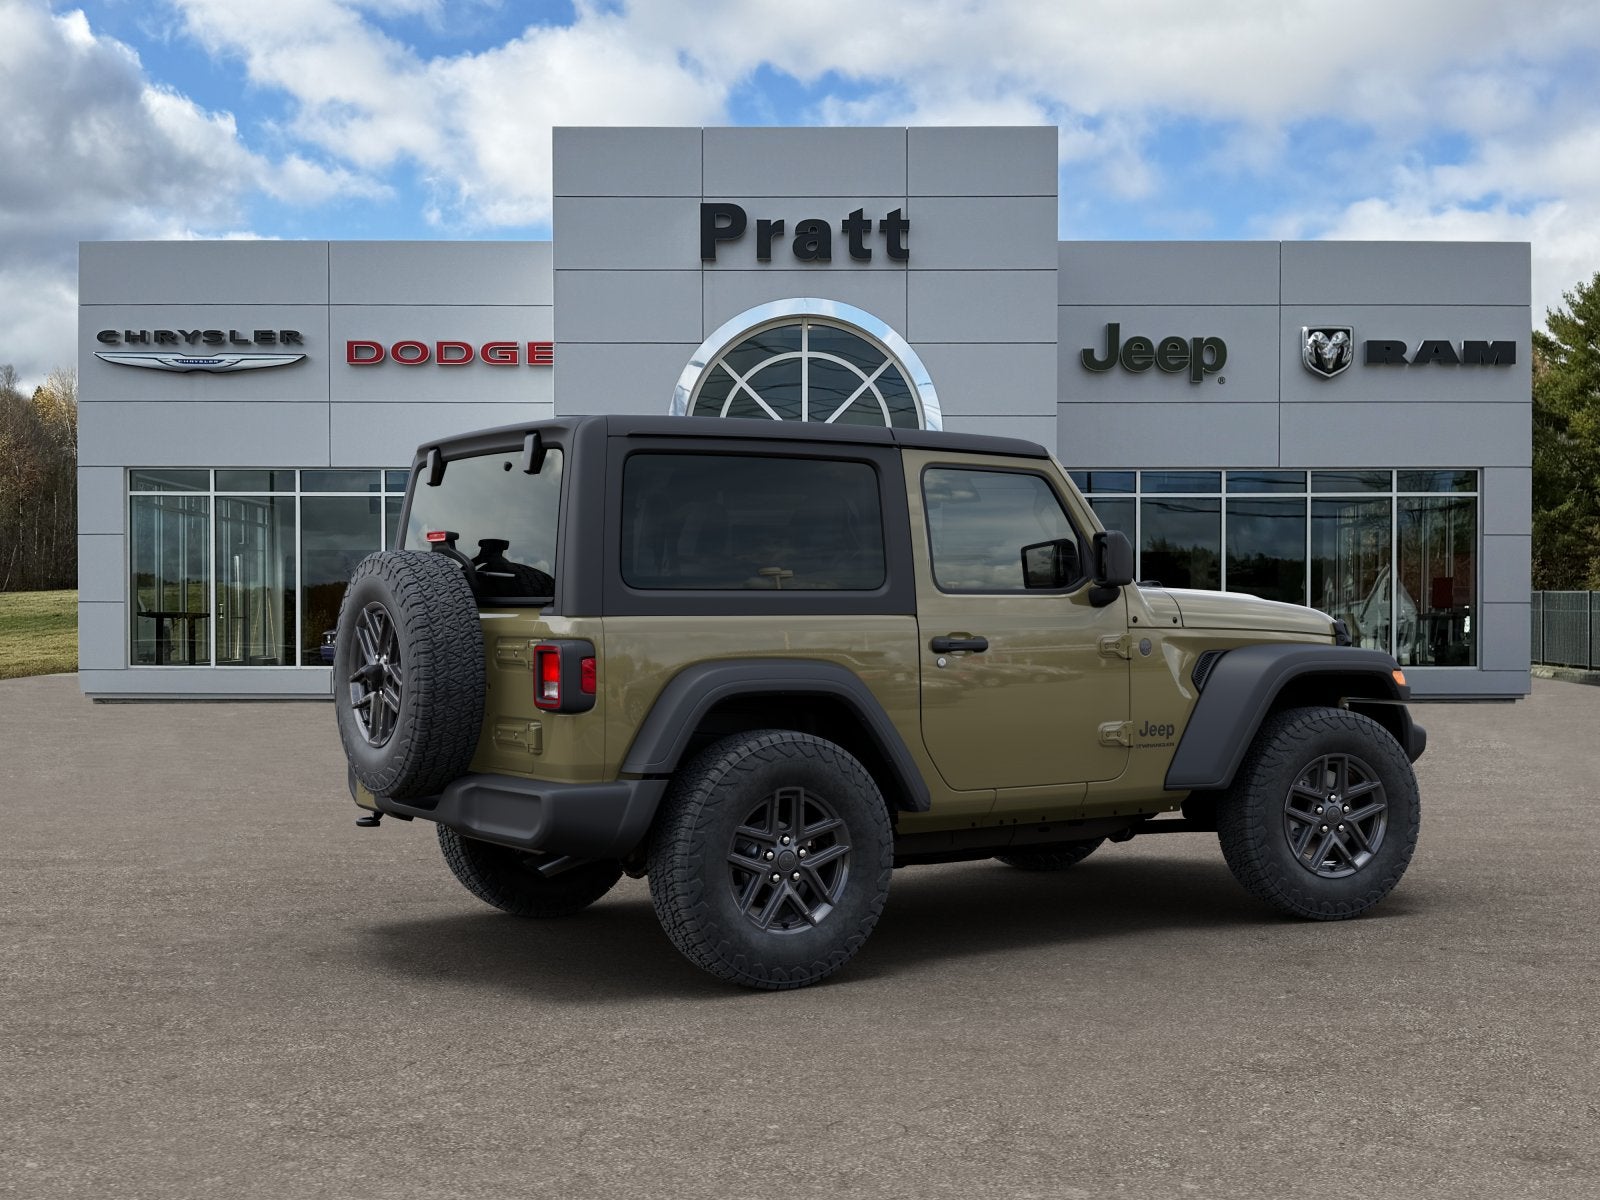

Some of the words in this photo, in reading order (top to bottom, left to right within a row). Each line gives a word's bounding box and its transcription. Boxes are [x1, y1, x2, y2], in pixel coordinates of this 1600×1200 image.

[700, 203, 910, 262] Pratt
[96, 329, 304, 345] CHRYSLER
[346, 340, 554, 365] DODGE
[1081, 322, 1228, 383] Jeep
[1364, 339, 1517, 365] RAM
[1139, 720, 1175, 740] Jeep
